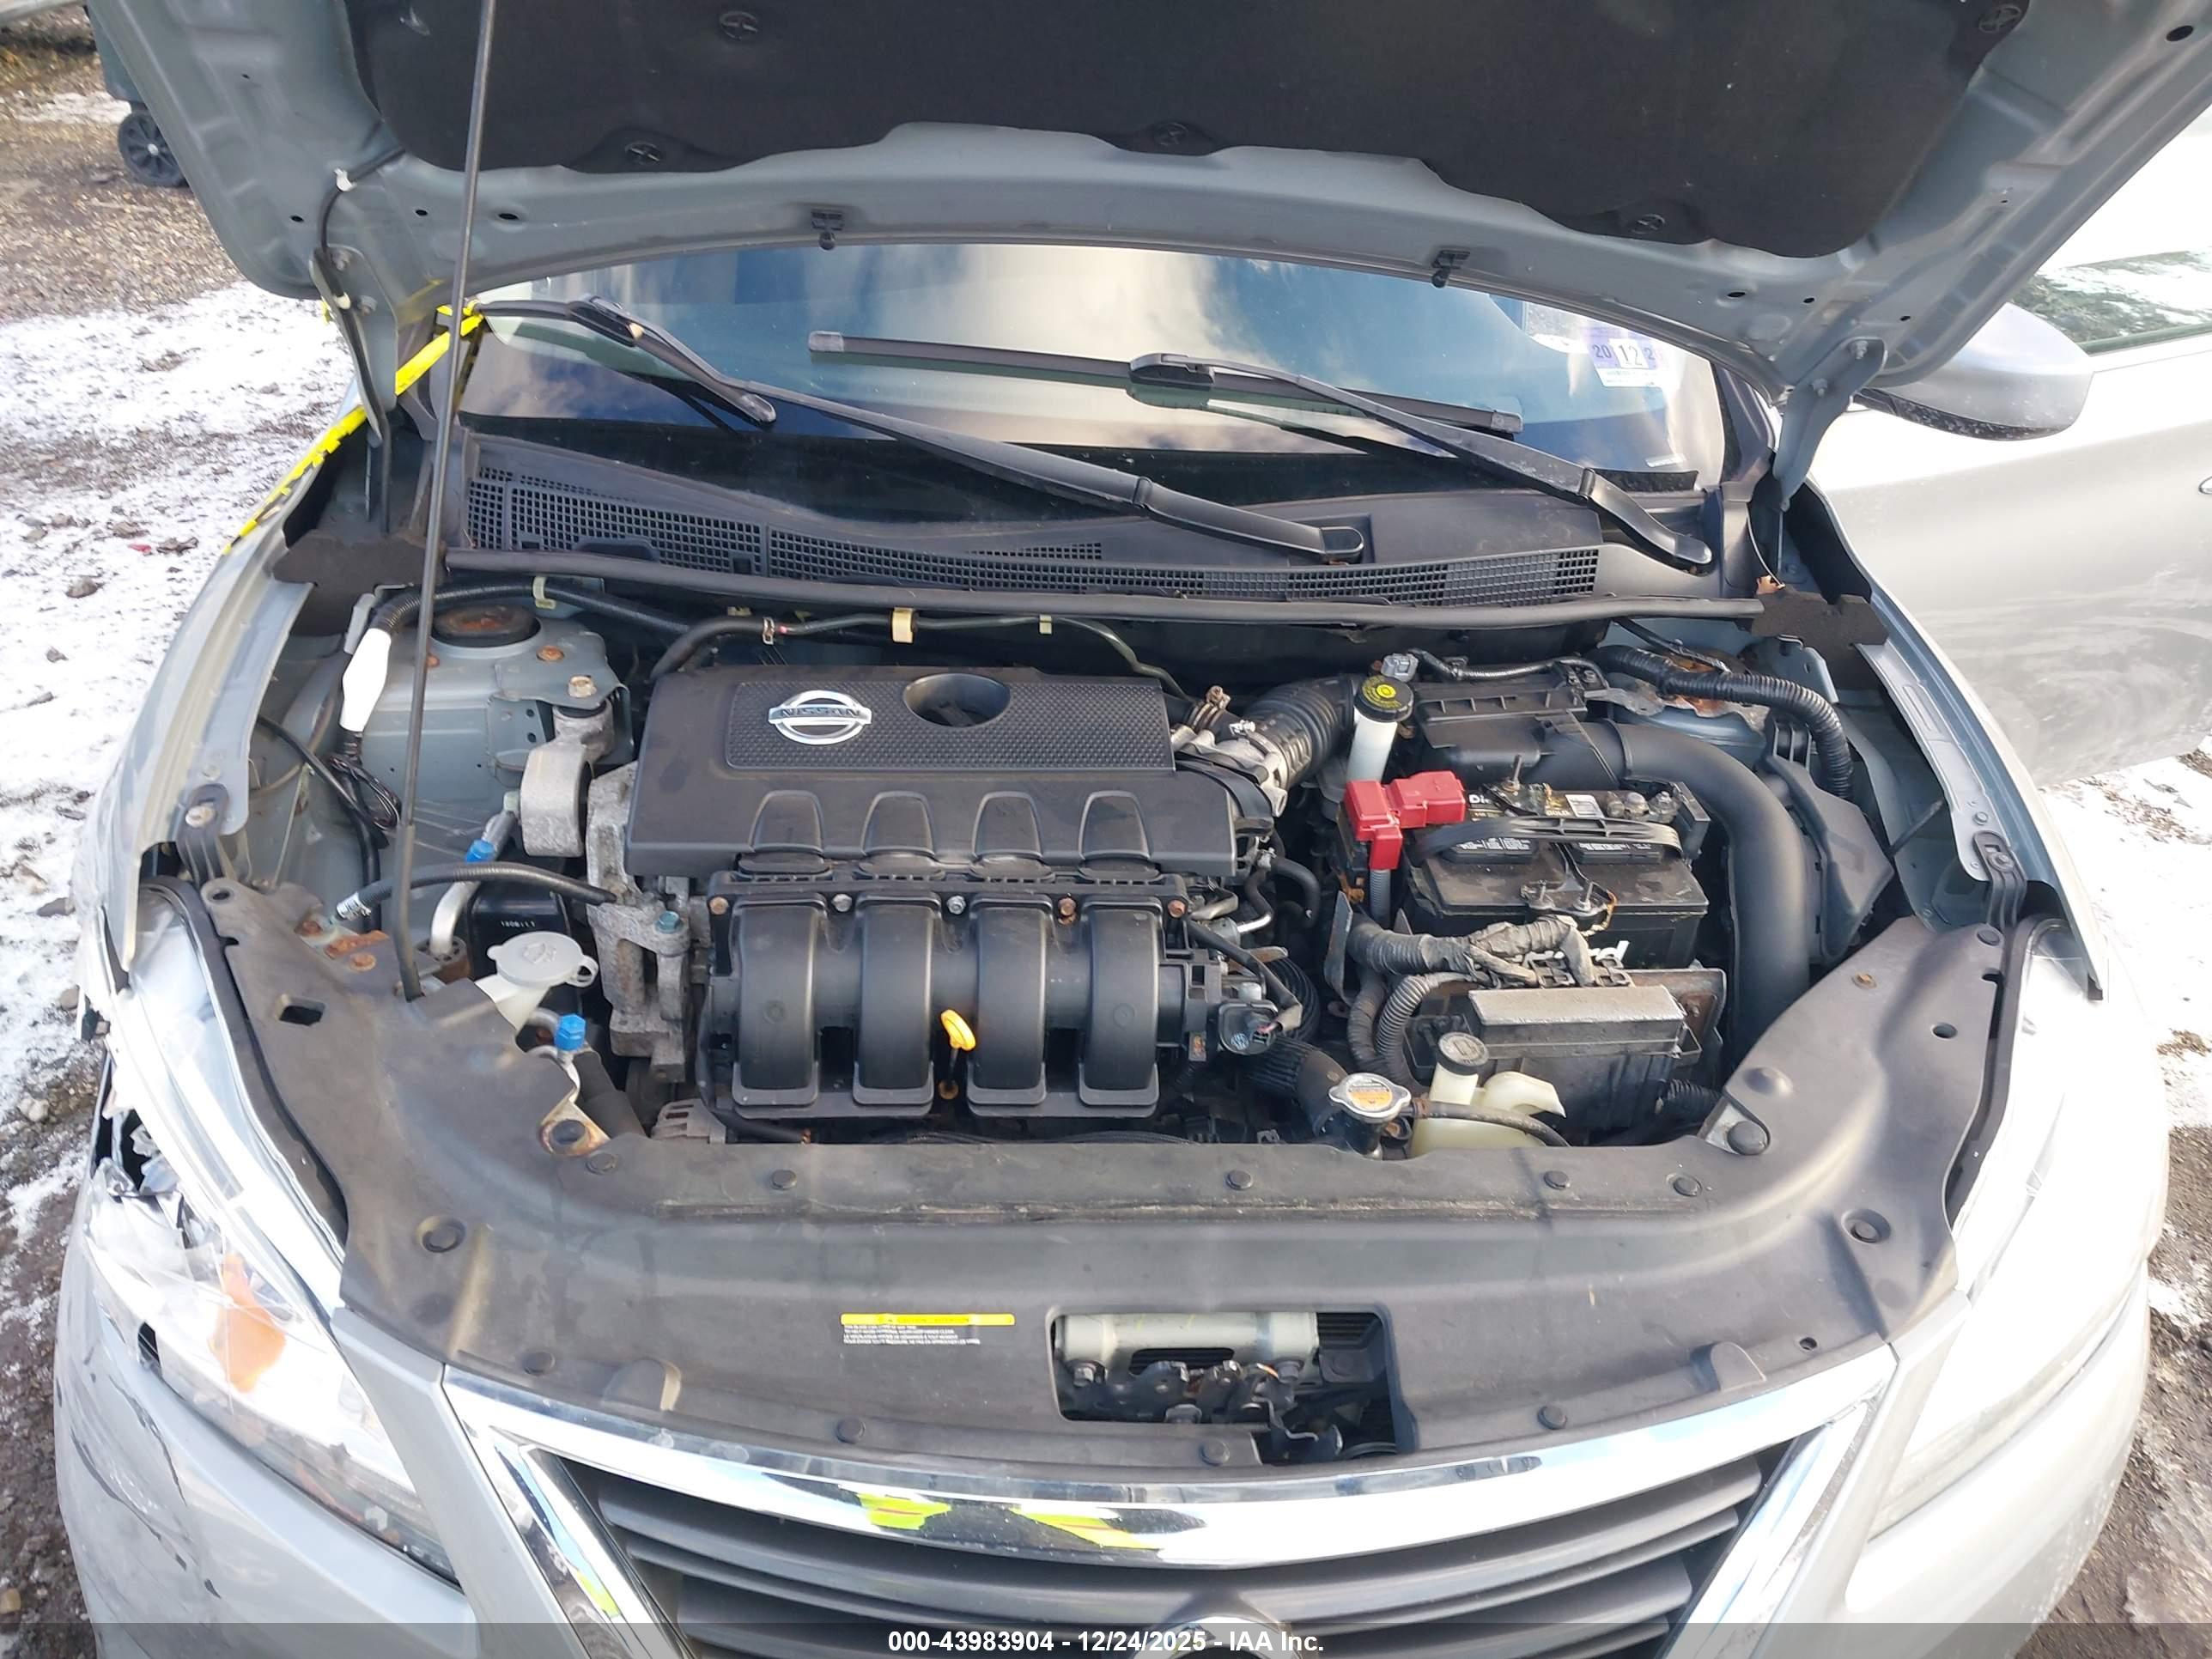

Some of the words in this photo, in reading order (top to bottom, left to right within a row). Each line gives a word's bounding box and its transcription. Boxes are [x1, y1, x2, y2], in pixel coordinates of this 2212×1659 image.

[1592, 344, 1613, 359] 20
[1618, 344, 1643, 366] 12
[781, 708, 858, 717] NISSAN
